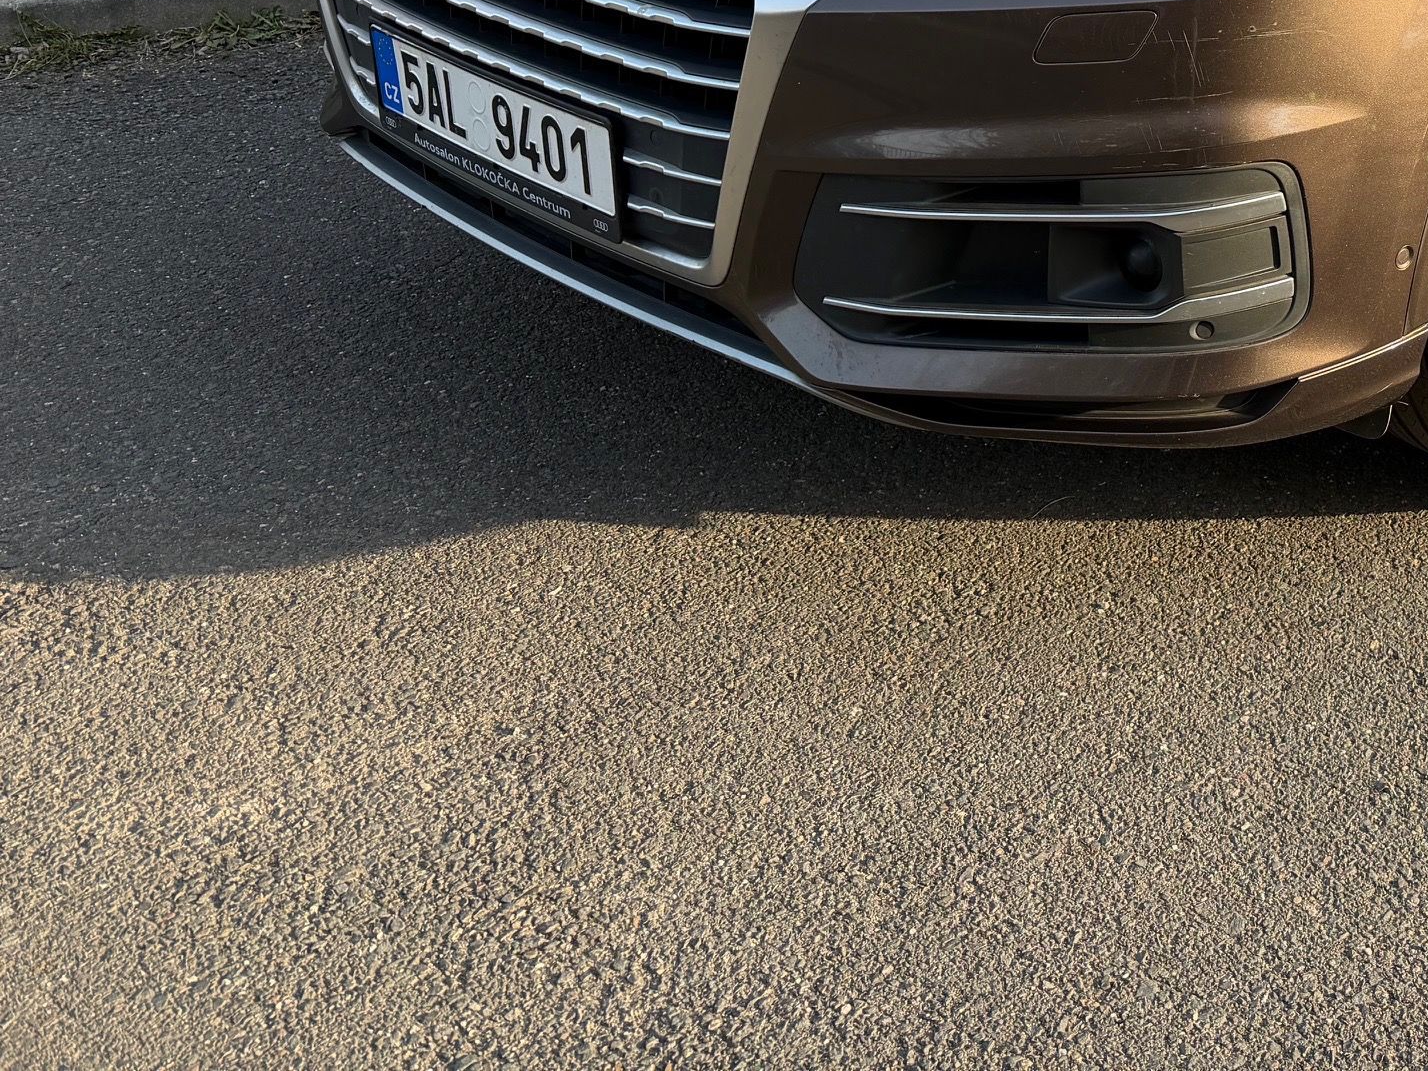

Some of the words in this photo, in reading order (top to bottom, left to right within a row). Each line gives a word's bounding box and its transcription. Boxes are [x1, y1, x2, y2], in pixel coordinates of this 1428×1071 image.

[384, 81, 400, 104] CZ
[401, 49, 467, 140] 5AL
[491, 93, 591, 196] 9401
[414, 132, 461, 166] Autosalon
[461, 157, 520, 196] KLOKOČKA
[522, 187, 571, 219] Centrum
